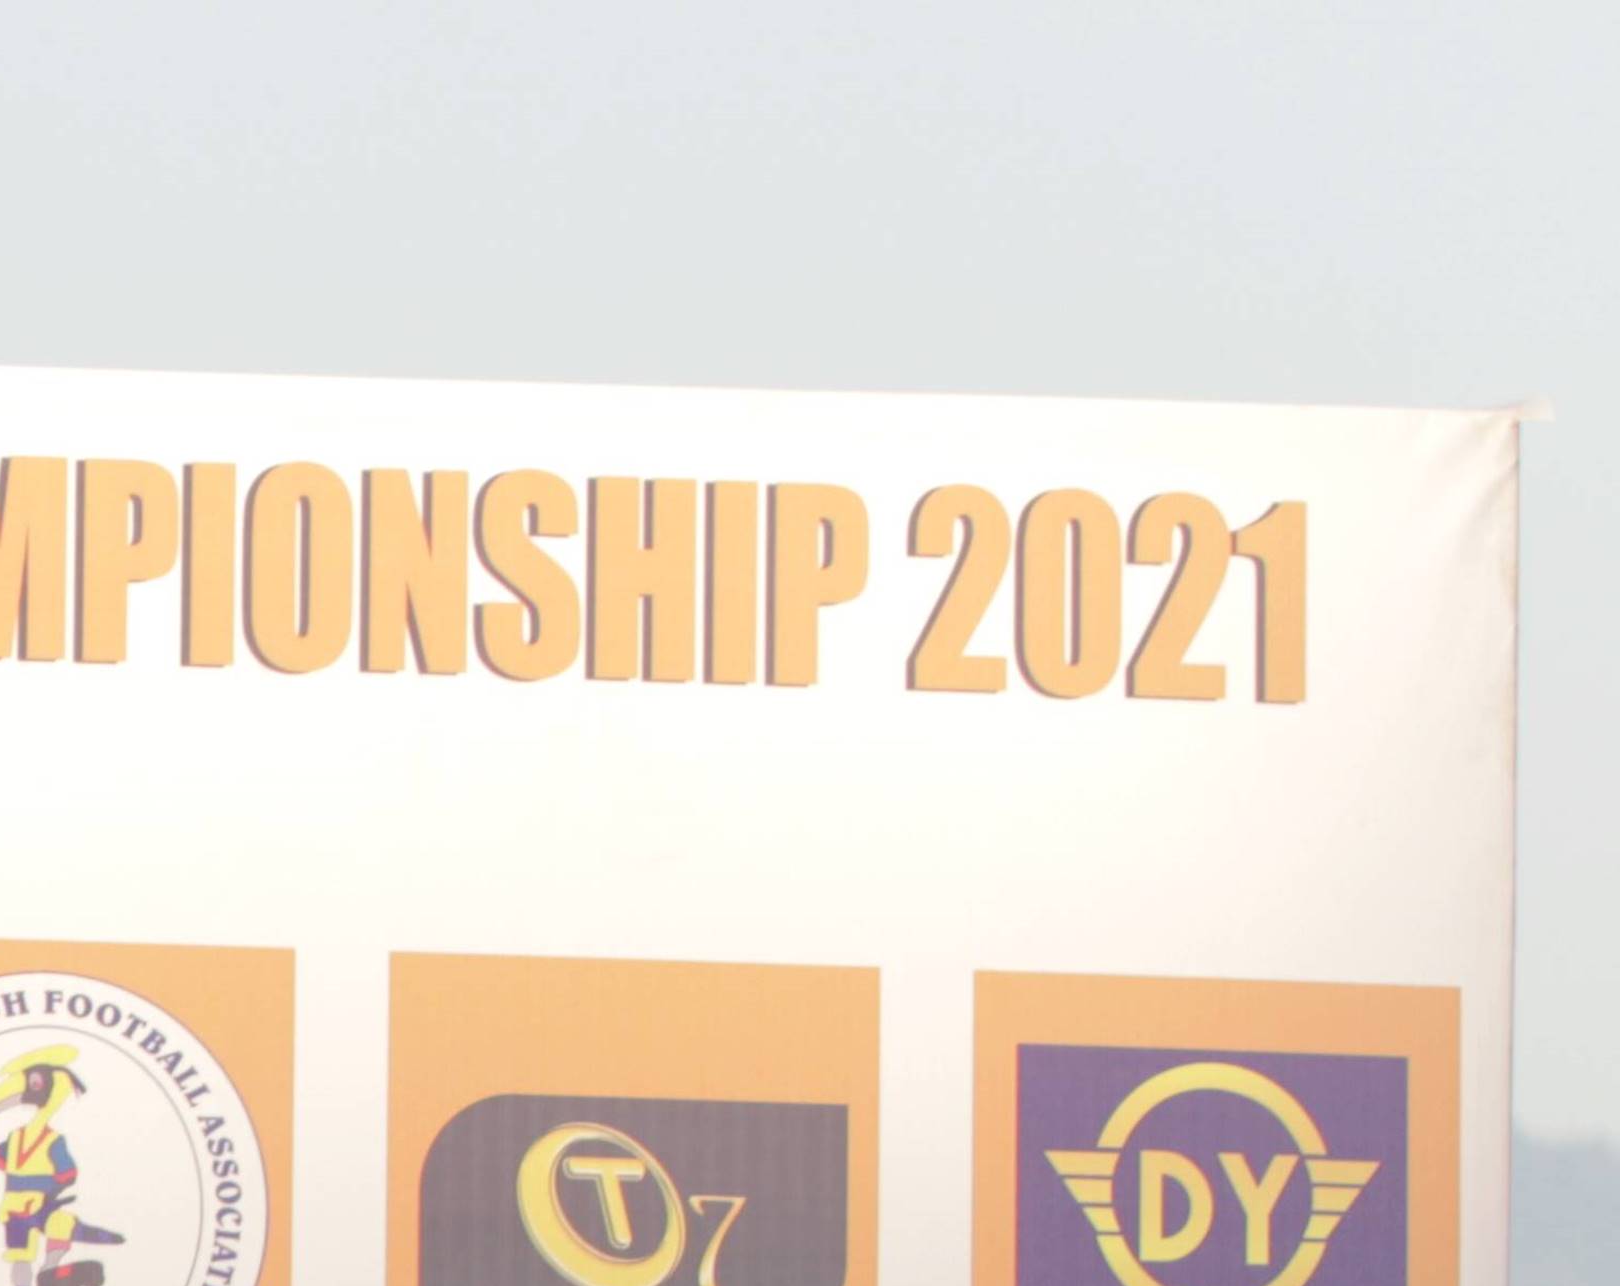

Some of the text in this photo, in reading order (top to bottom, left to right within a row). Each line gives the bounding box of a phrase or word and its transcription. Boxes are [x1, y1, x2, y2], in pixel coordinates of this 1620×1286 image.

[905, 482, 1309, 705] 2021
[43, 990, 211, 1108] FOOTBALL
[1140, 1149, 1300, 1266] DY
